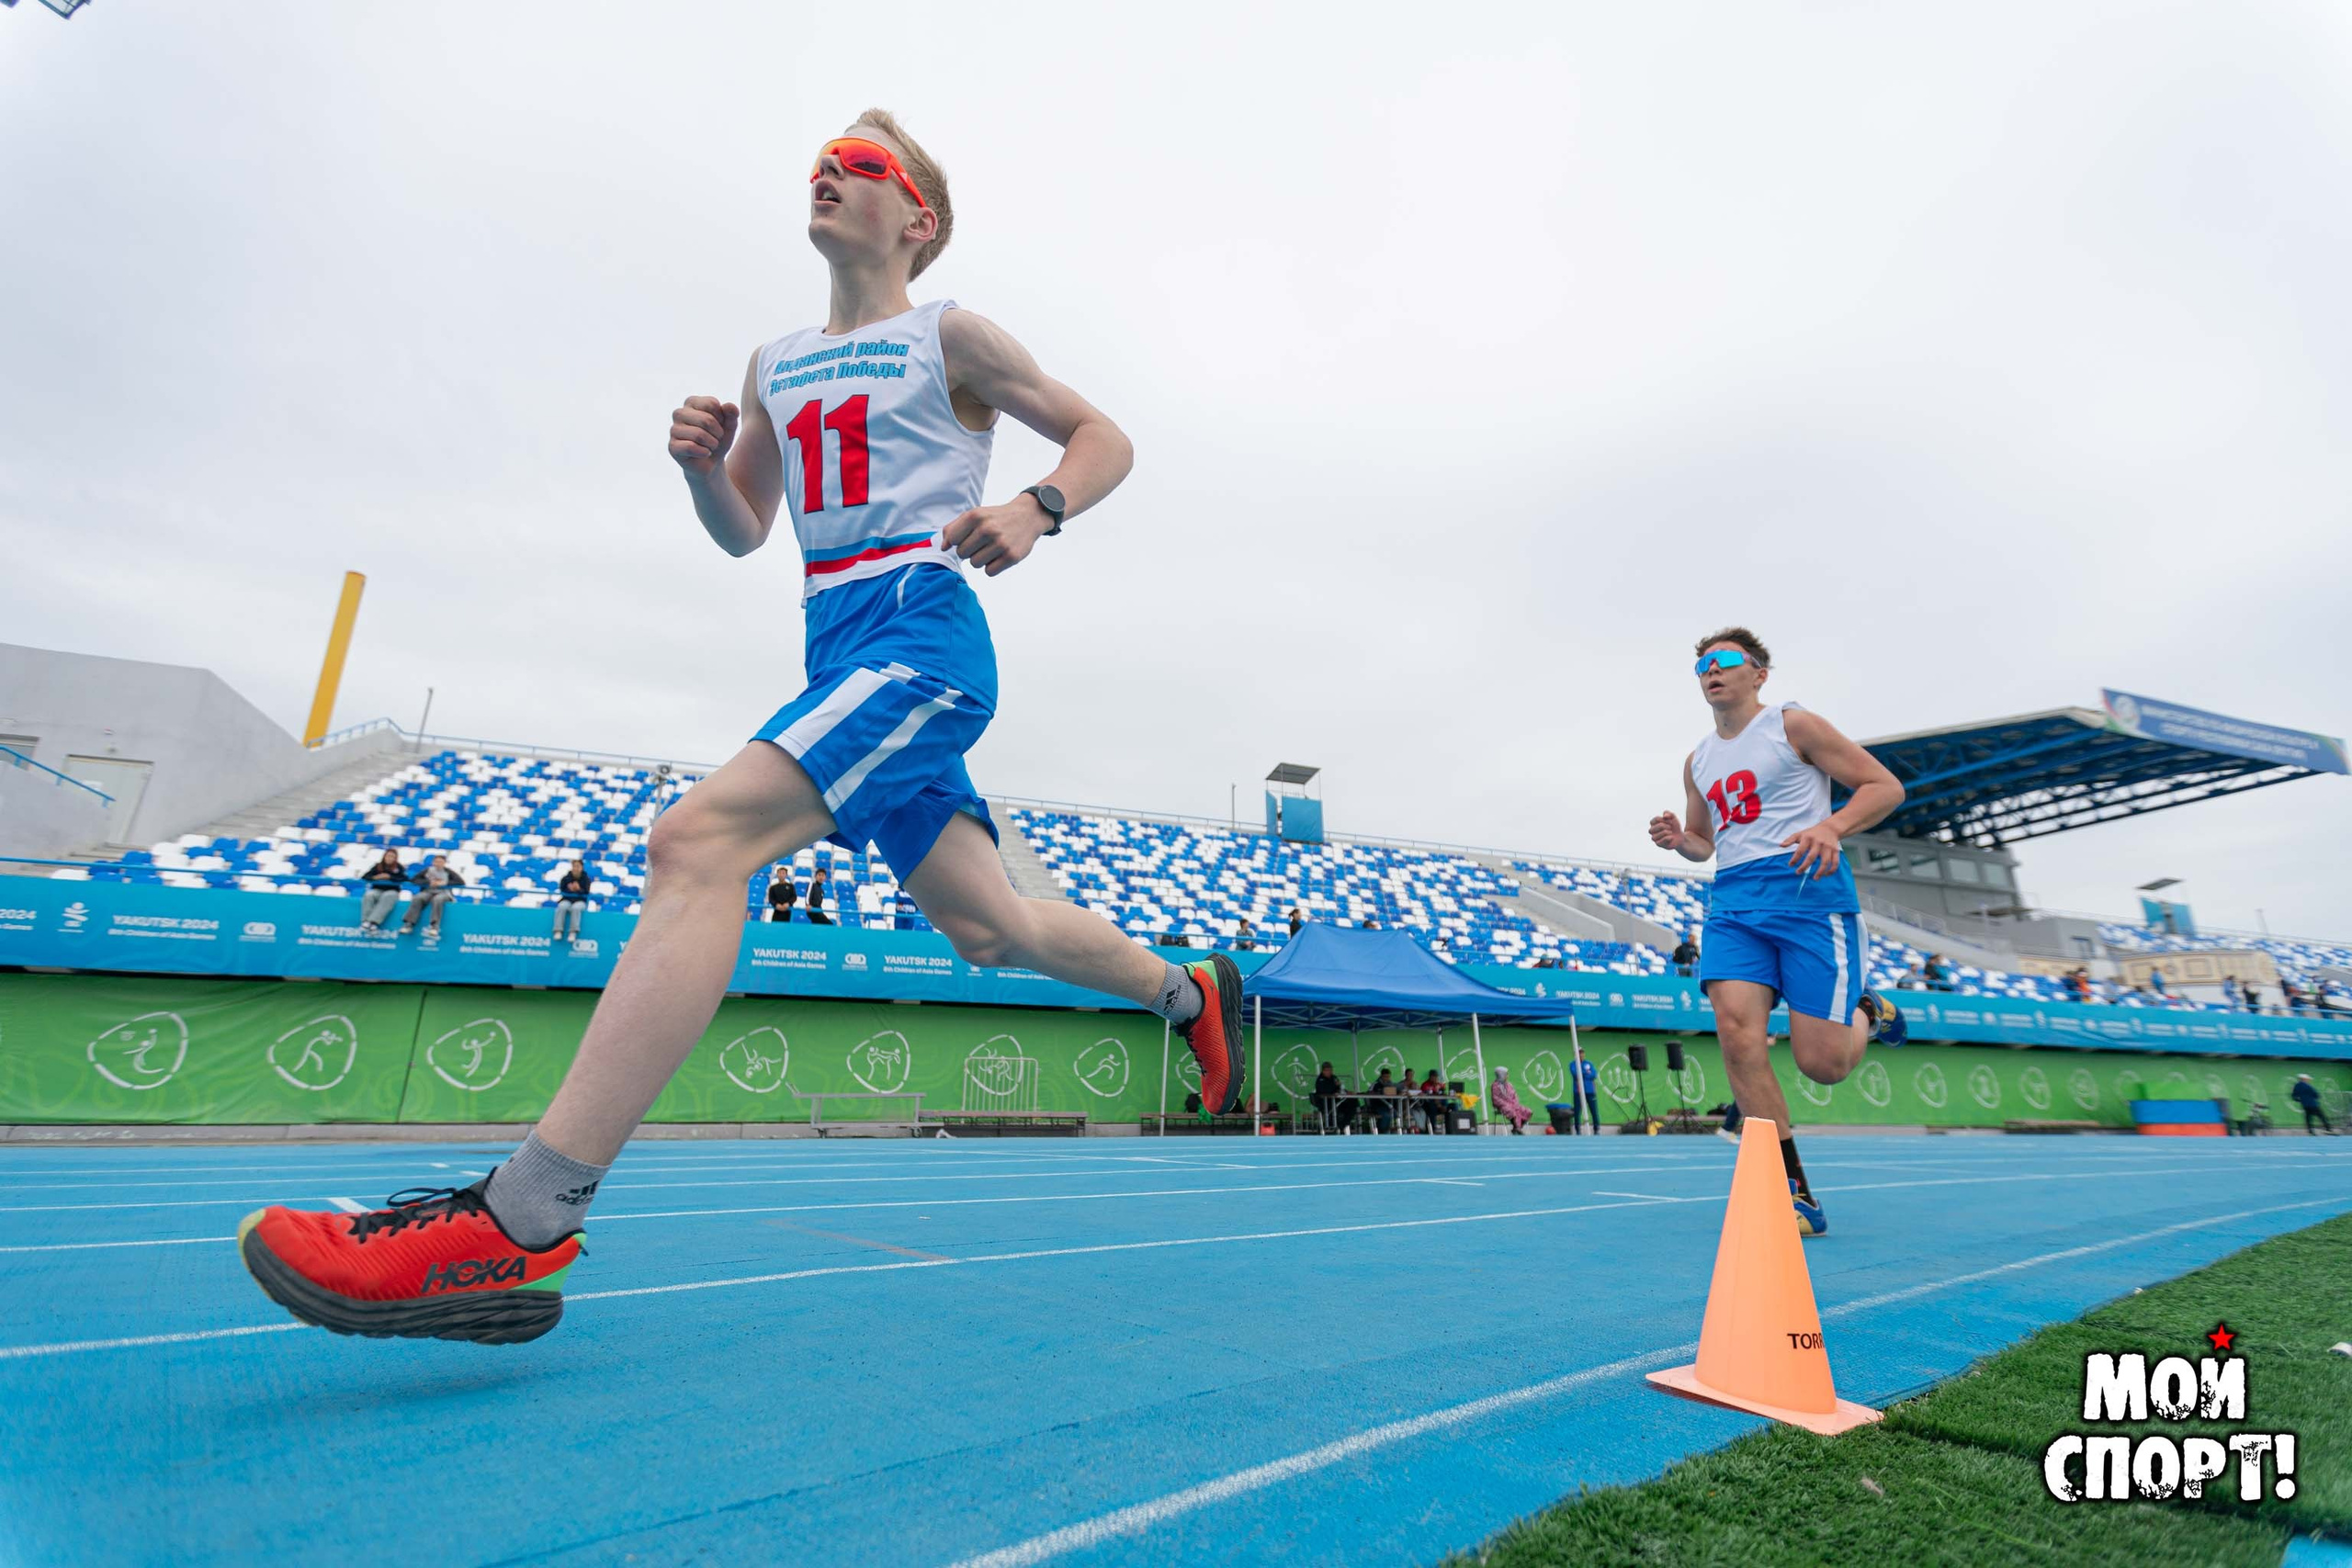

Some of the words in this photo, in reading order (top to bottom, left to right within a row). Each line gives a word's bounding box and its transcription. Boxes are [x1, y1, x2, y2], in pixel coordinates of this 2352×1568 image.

[855, 339, 910, 357] район
[836, 361, 907, 378] Победы
[786, 394, 870, 514] 11
[1706, 769, 1762, 832] 13
[463, 933, 518, 946] YAKUTSK
[520, 936, 551, 947] 2024
[753, 948, 799, 960] YAKUTSK
[800, 950, 827, 961] 2024
[884, 954, 927, 965] YAKUTSK
[928, 956, 953, 967] 2024
[421, 1256, 526, 1293] HOKA
